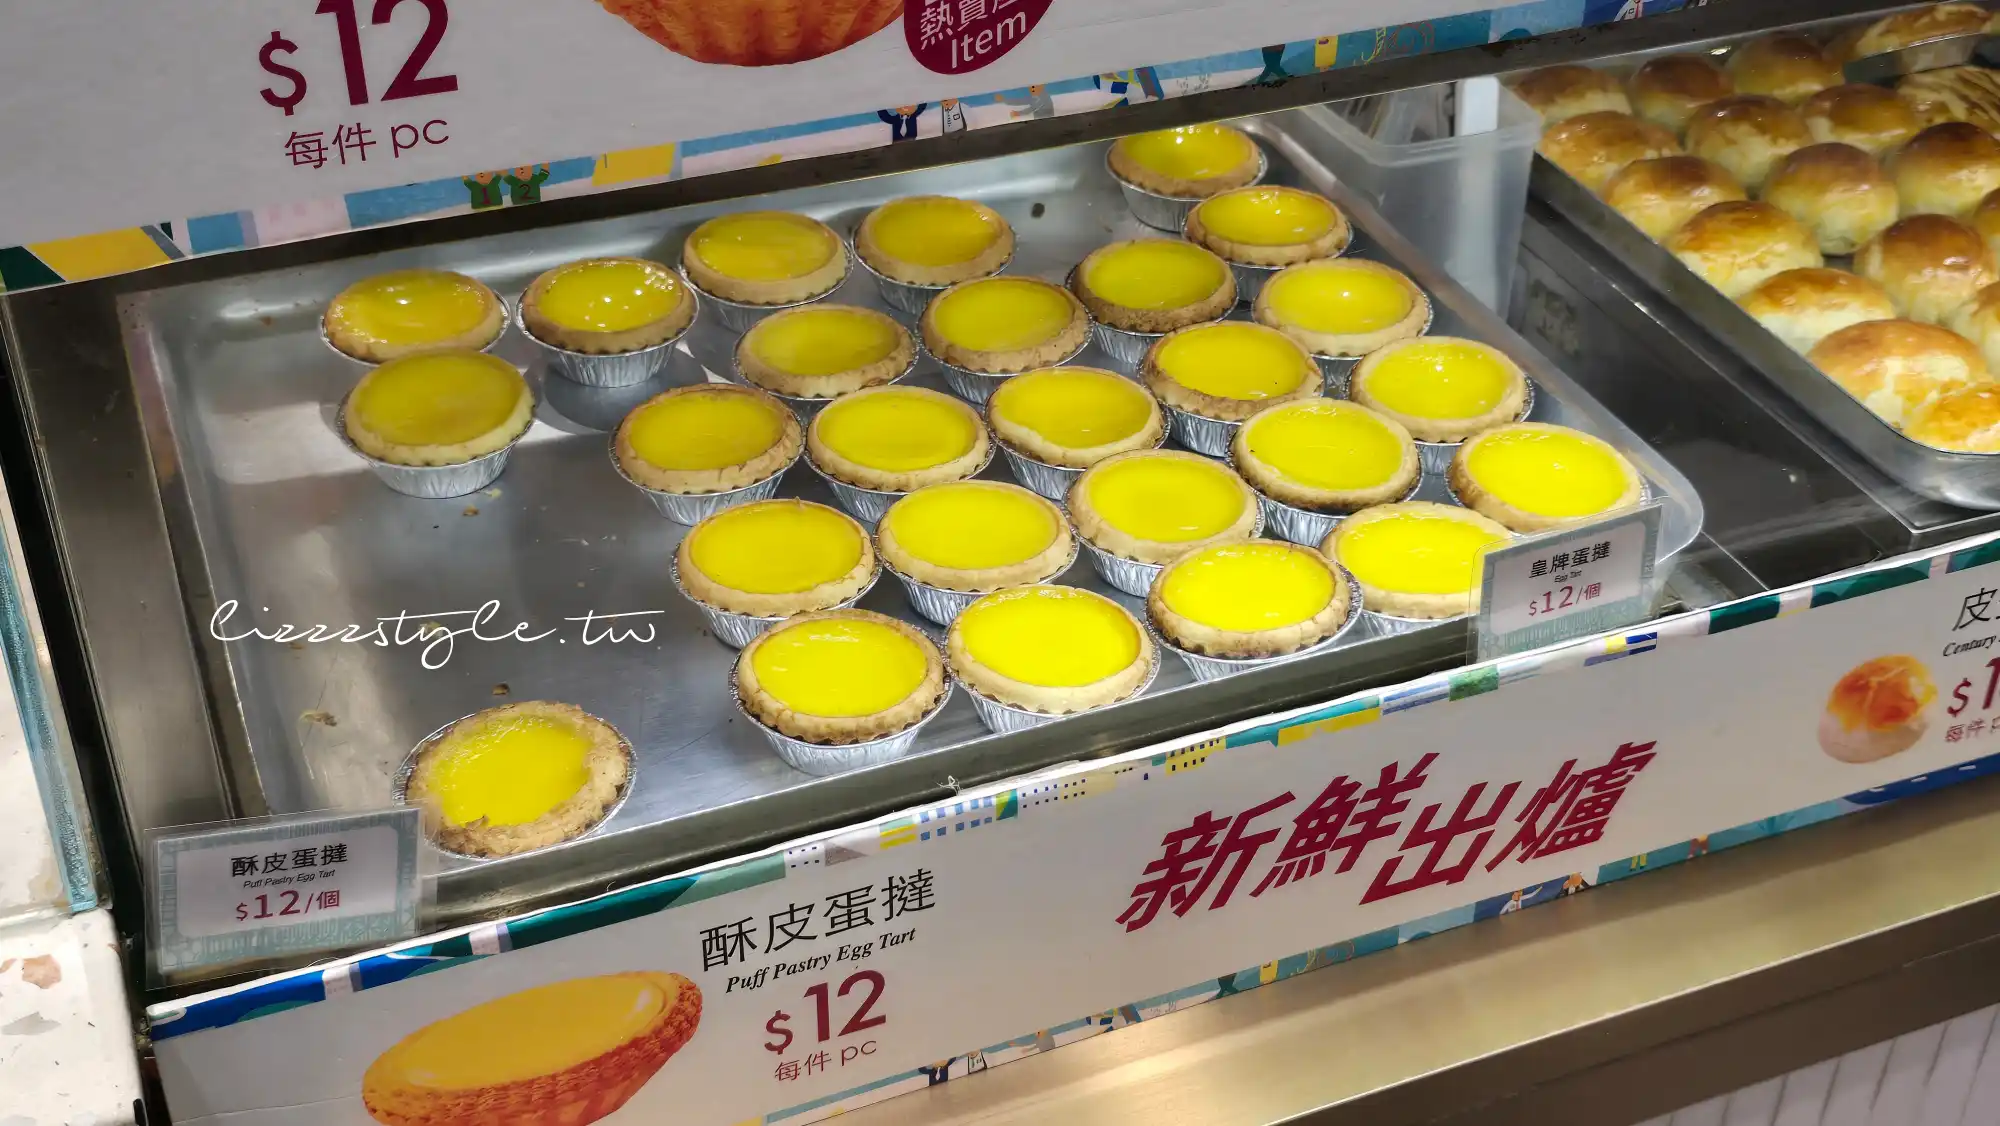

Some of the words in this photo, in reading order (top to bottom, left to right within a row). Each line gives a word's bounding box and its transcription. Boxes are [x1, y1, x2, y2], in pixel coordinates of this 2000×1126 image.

[258, 0, 459, 117] $12
[951, 11, 1026, 69] Item
[284, 122, 377, 169] 每件
[391, 119, 449, 158] pc
[1529, 541, 1611, 578] 皇牌蛋撻
[1952, 587, 2000, 631] 皮
[1943, 635, 1997, 657] Century
[1947, 657, 2000, 718] $1
[230, 843, 348, 877] 酥皮蛋撻
[1115, 740, 1658, 933] 新鮮出爐
[243, 880, 262, 889] Puff
[265, 876, 294, 888] Pastry
[296, 872, 315, 883] Egg
[319, 869, 336, 879] Tart
[699, 867, 936, 972] 酥皮蛋撻
[725, 966, 770, 993] Puff
[772, 952, 832, 980] Pastry
[836, 941, 873, 962] Egg
[879, 927, 916, 950] Tart
[764, 969, 886, 1055] $12
[774, 1050, 832, 1081] 每件
[841, 1040, 877, 1066] pc
